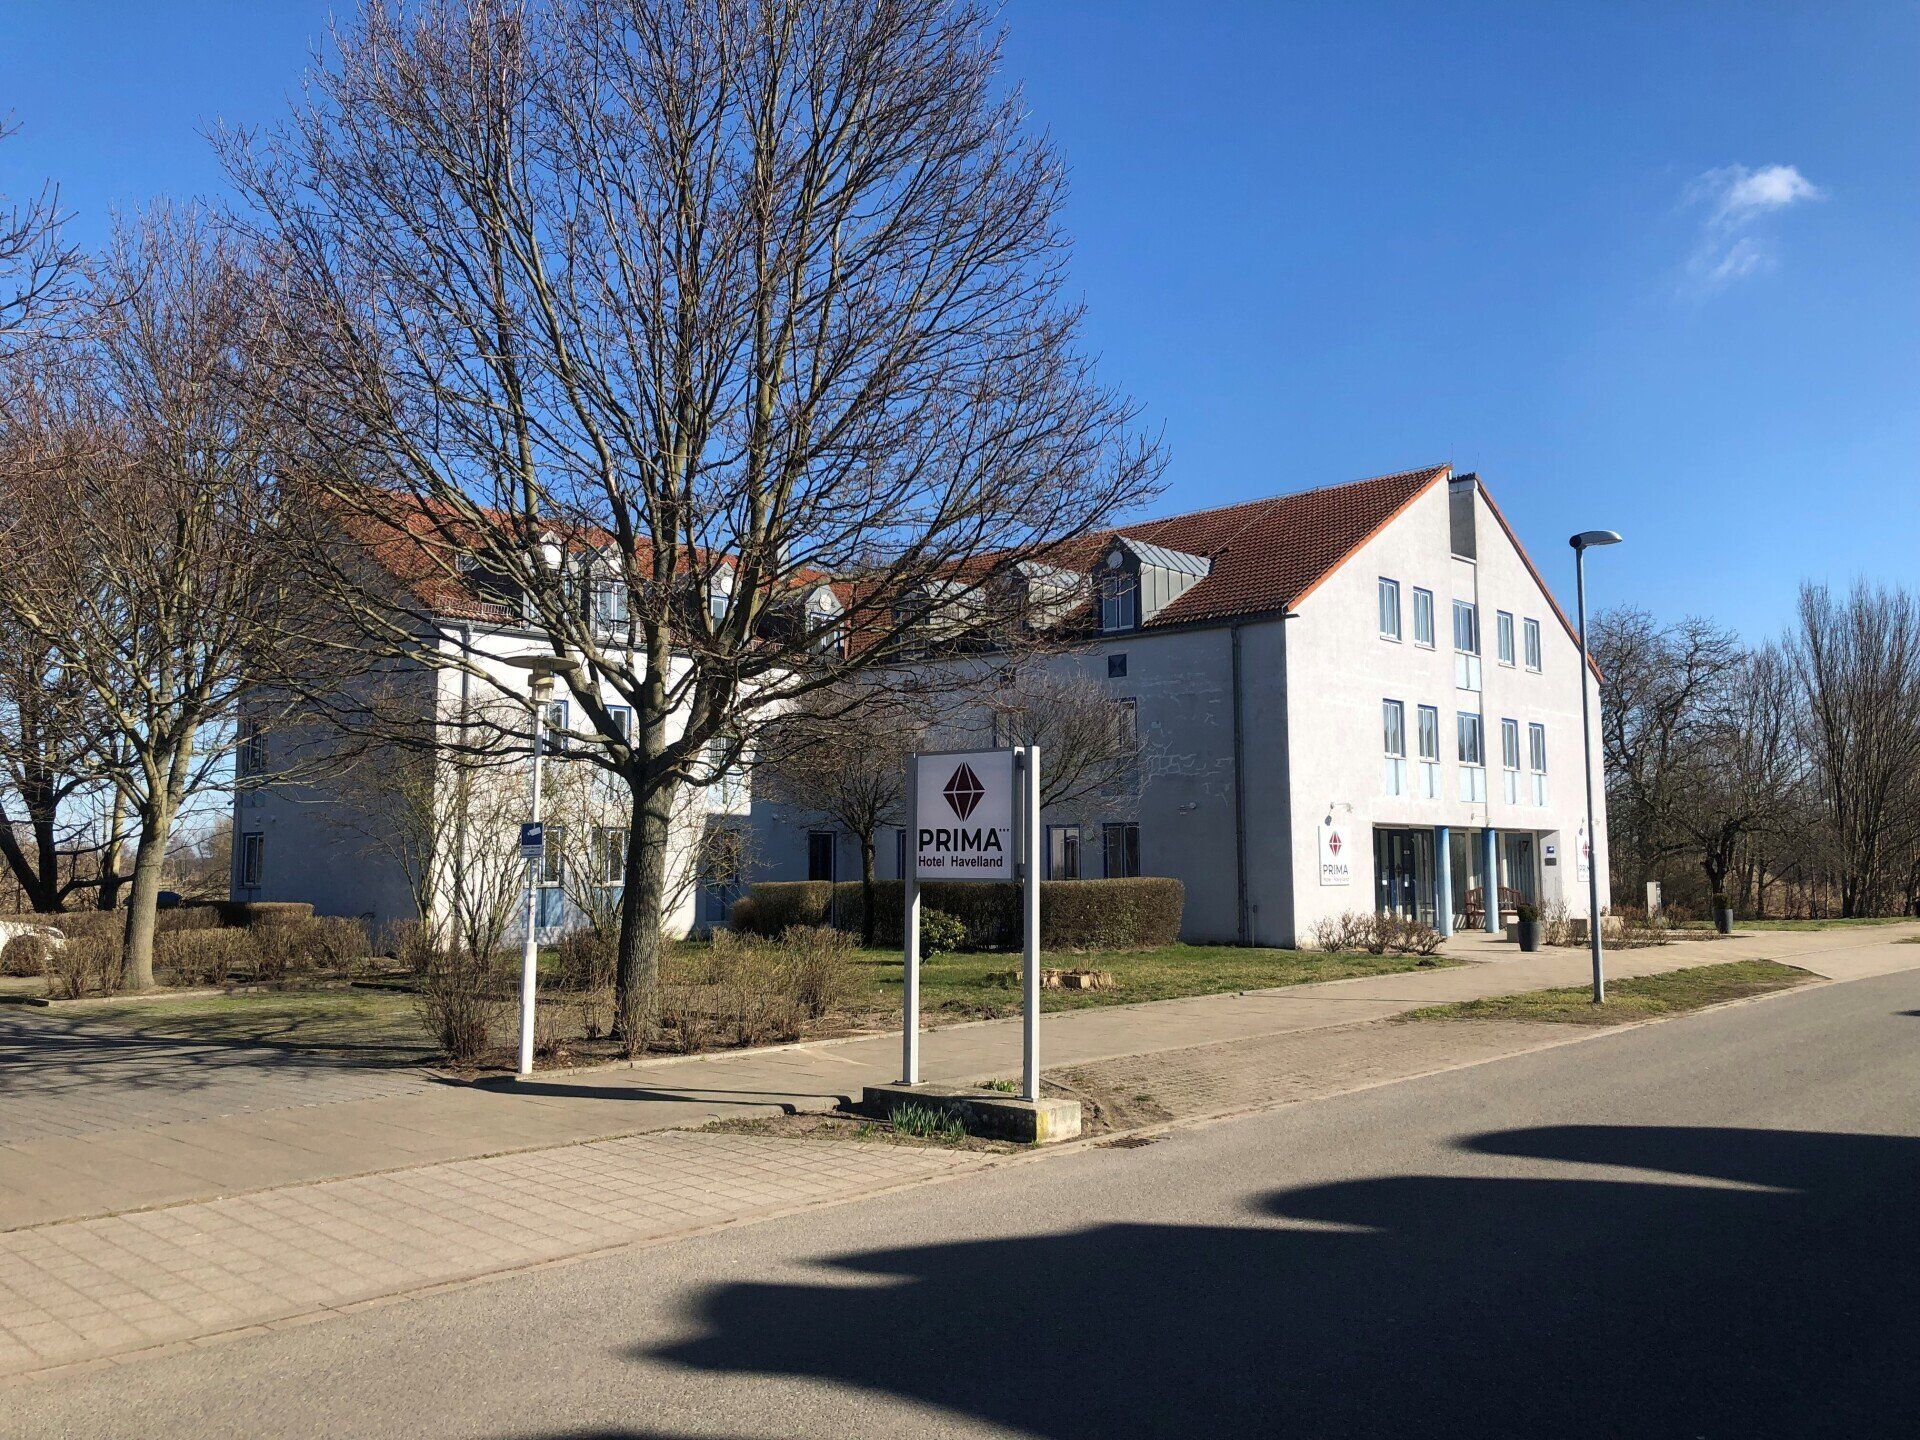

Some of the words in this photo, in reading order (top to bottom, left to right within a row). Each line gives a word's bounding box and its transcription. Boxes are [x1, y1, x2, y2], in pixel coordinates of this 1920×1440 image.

[918, 828, 1003, 852] PRIMA
[918, 856, 945, 867] Hotel
[951, 856, 1003, 867] Havelland
[1323, 864, 1349, 875] PRIMA
